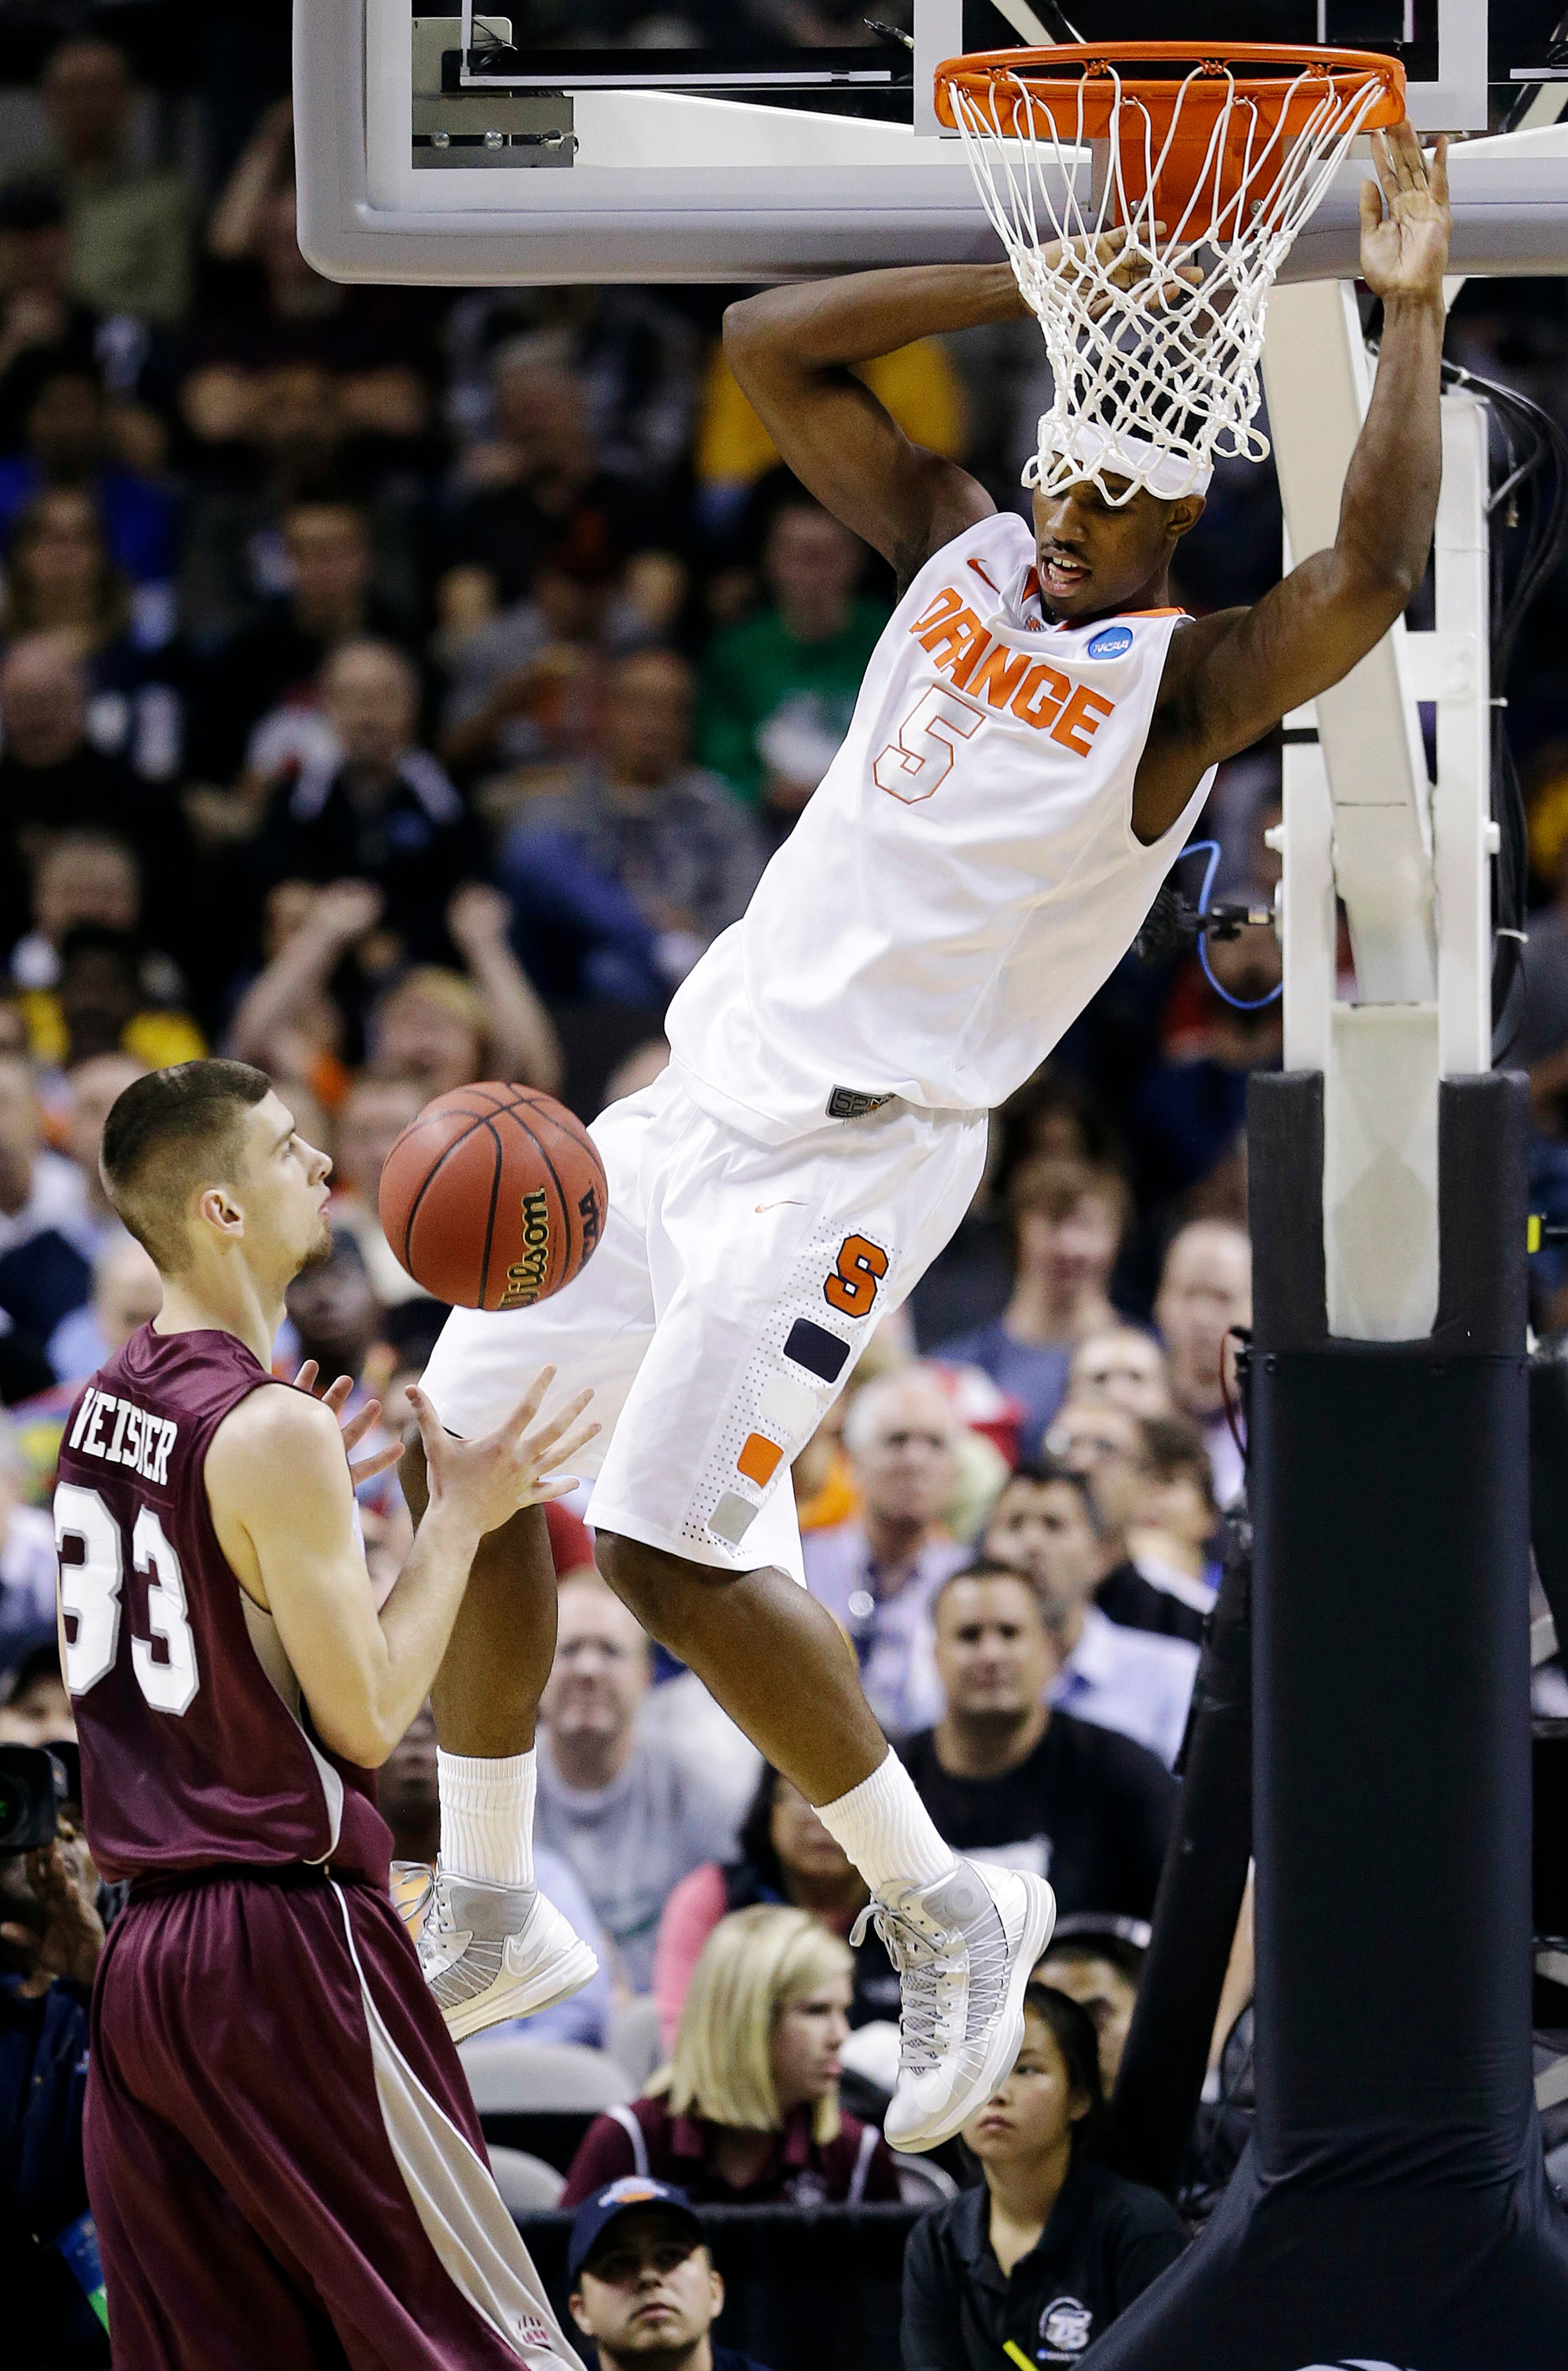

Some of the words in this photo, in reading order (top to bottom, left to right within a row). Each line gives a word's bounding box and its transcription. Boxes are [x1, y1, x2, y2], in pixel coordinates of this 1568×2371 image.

[909, 587, 1115, 758] ORANGE
[1092, 639, 1130, 654] NCAA
[873, 683, 986, 804] 5
[577, 1185, 599, 1271] CAA
[823, 1233, 889, 1318] S
[53, 1481, 200, 1717] 33
